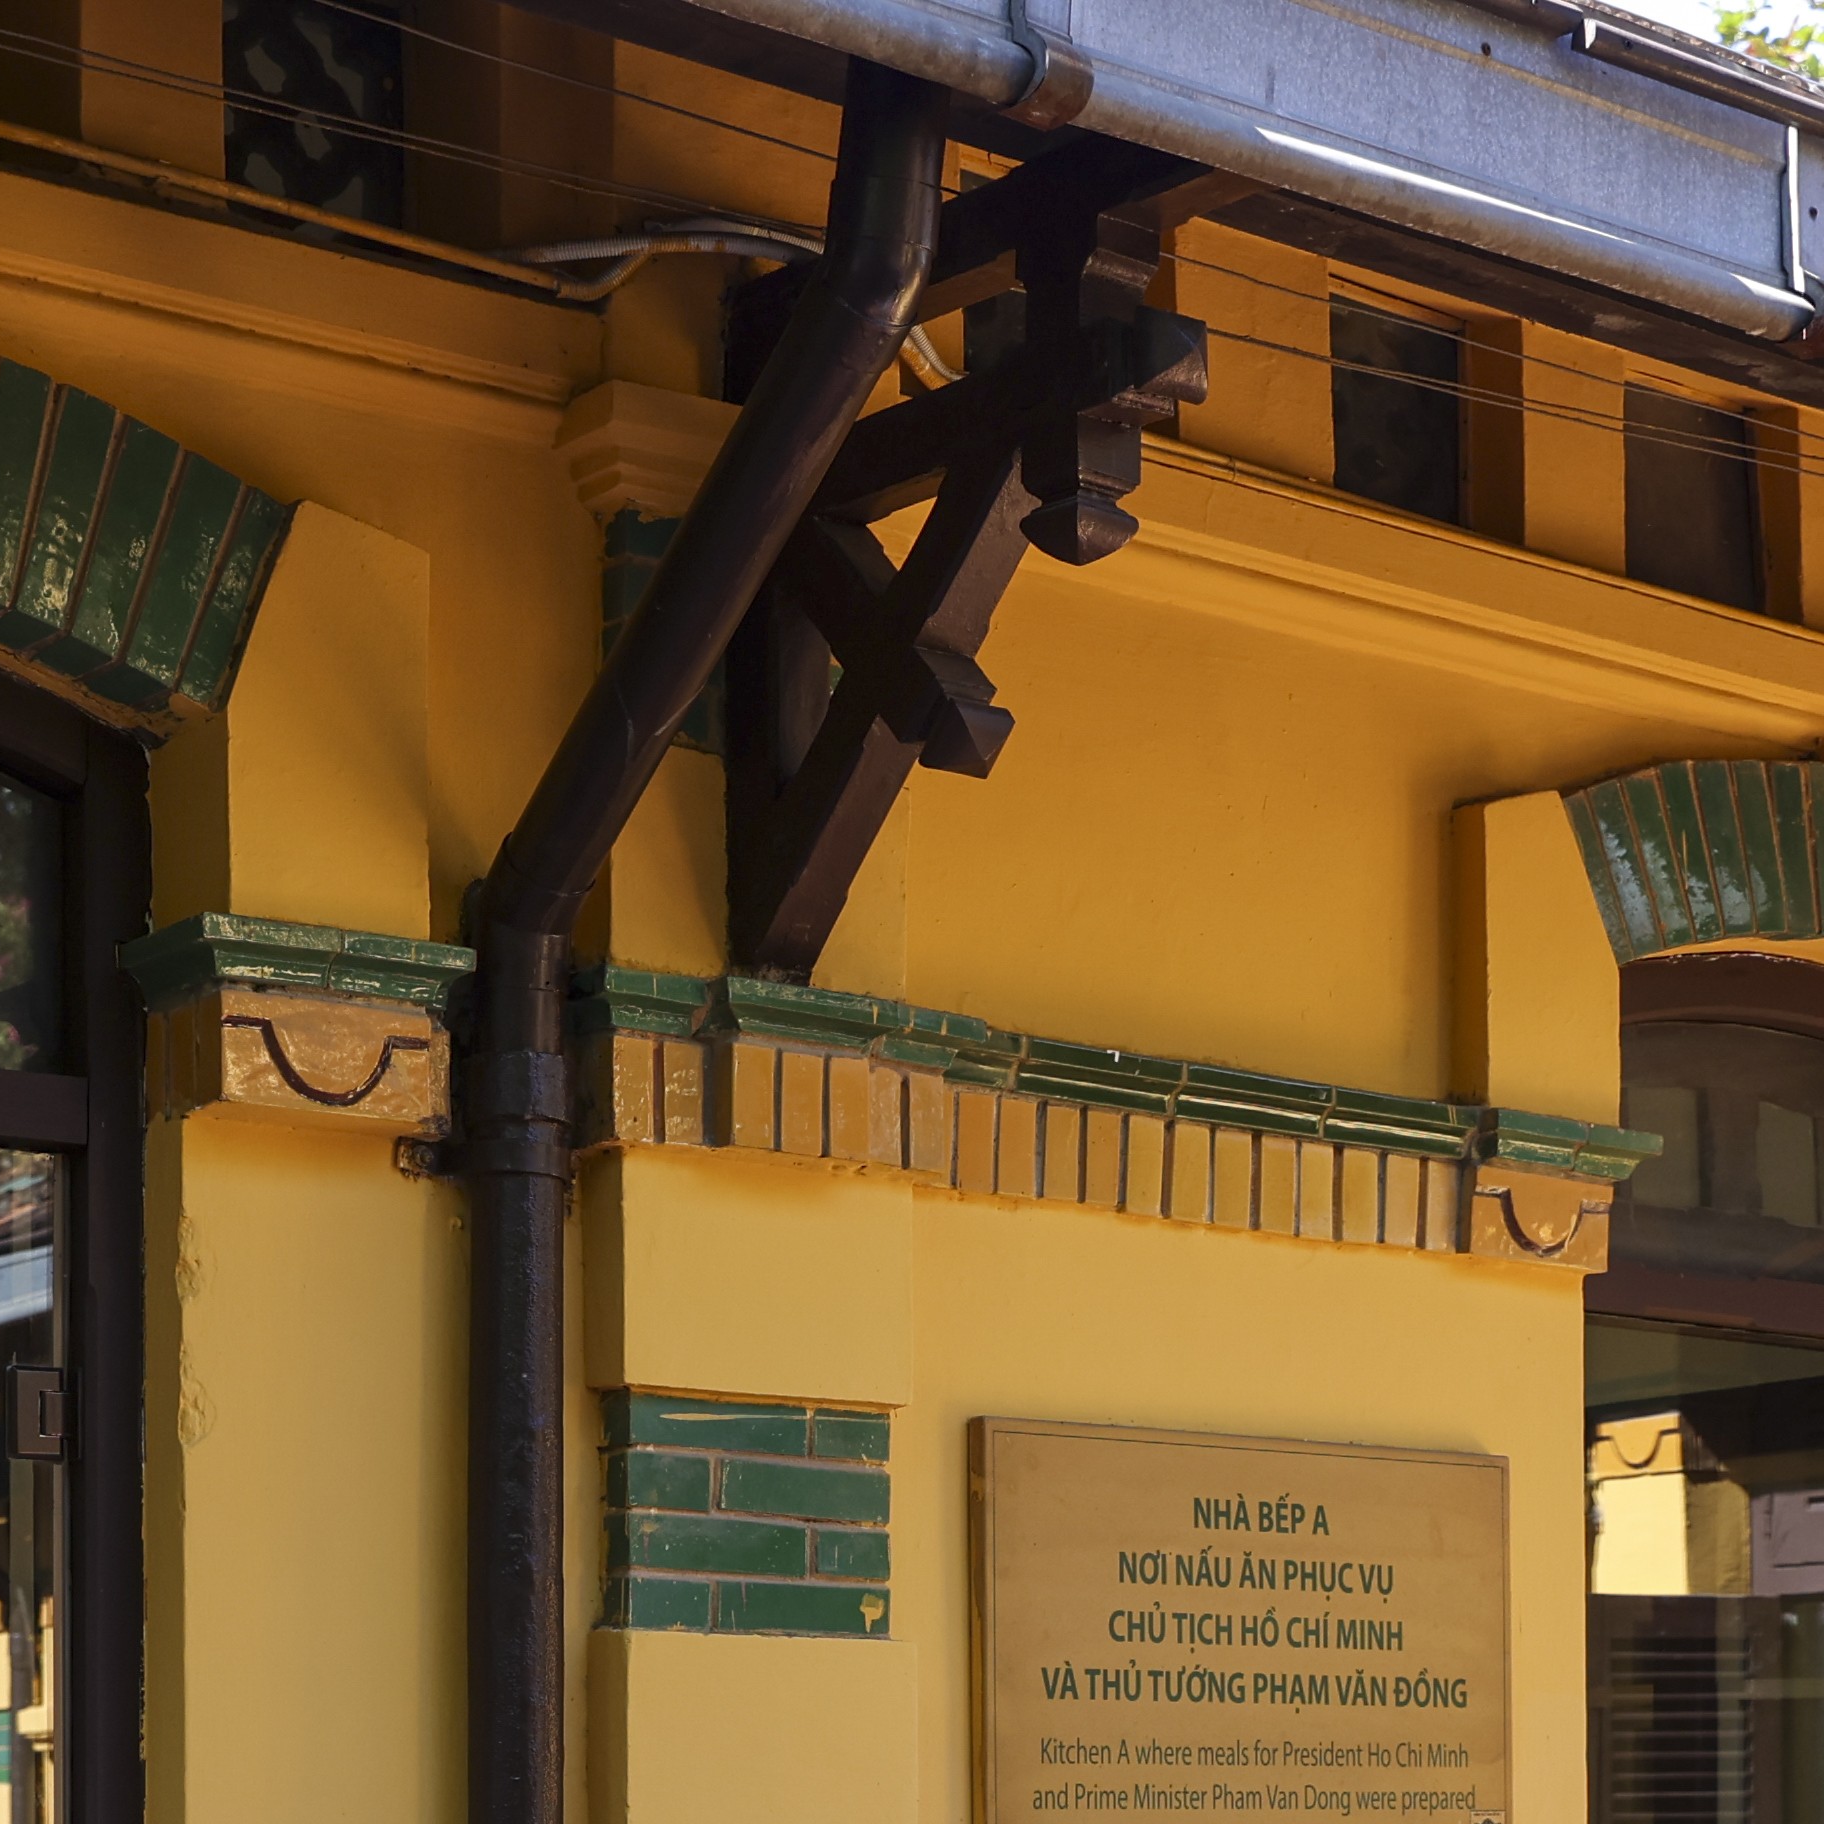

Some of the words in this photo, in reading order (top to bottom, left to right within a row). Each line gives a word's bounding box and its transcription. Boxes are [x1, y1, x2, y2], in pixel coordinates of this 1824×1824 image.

[1193, 1493, 1250, 1531] NHÀ
[1259, 1493, 1305, 1533] BẾP
[1312, 1504, 1329, 1535] A
[1118, 1550, 1167, 1585] NƠI
[1176, 1545, 1230, 1587] NẤU
[1240, 1551, 1275, 1589] ĂN
[1284, 1559, 1352, 1601] PHỤC
[1359, 1564, 1394, 1603] VỤ
[1109, 1601, 1166, 1643] CHỦ
[1172, 1612, 1232, 1653] TỊCH
[1241, 1606, 1279, 1647] HỒ
[1286, 1611, 1329, 1649] CHÍ
[1337, 1619, 1403, 1651] MINH
[1041, 1661, 1078, 1699] VÀ
[1085, 1659, 1141, 1701] THỦ
[1147, 1665, 1245, 1704] TƯỚNG
[1253, 1672, 1329, 1713] PHẠM
[1336, 1669, 1386, 1706] VĂN
[1394, 1668, 1467, 1708] ĐỒNG
[1040, 1737, 1111, 1765] Kitchen
[1117, 1740, 1130, 1765] A
[1135, 1739, 1192, 1766] where
[1197, 1740, 1249, 1766] meals
[1253, 1740, 1277, 1766] for
[1283, 1741, 1362, 1767] President
[1367, 1743, 1391, 1767] Ho
[1395, 1743, 1422, 1768] Chi
[1428, 1744, 1468, 1768] Minh
[1033, 1782, 1068, 1810] and
[1074, 1784, 1128, 1810] Prime
[1134, 1784, 1207, 1810] Minister
[1213, 1784, 1261, 1810] Pham
[1266, 1785, 1298, 1810] Van
[1305, 1786, 1350, 1816] Dong
[1356, 1792, 1395, 1810] were
[1402, 1786, 1476, 1816] prepared
